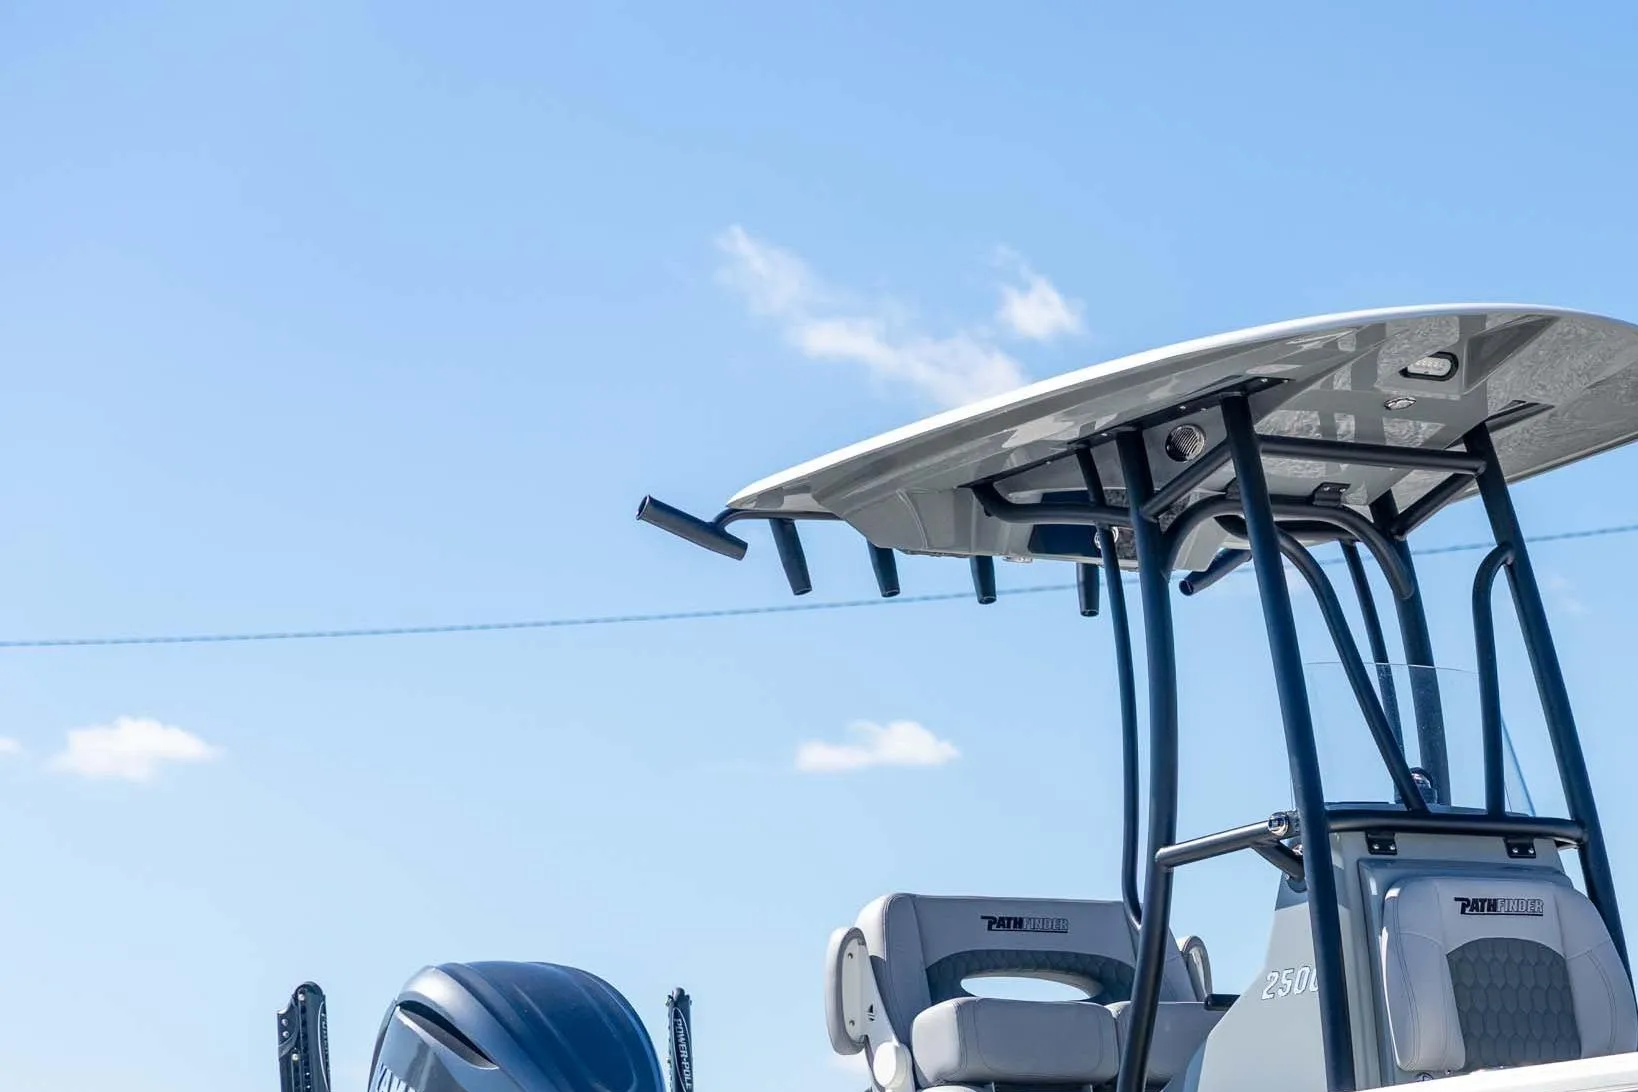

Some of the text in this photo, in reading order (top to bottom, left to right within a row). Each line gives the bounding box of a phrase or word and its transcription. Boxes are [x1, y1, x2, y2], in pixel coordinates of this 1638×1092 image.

[1454, 896, 1544, 917] PATHFINDER
[980, 915, 1069, 934] PATHFINDER
[673, 1018, 693, 1090] POWER-POLE
